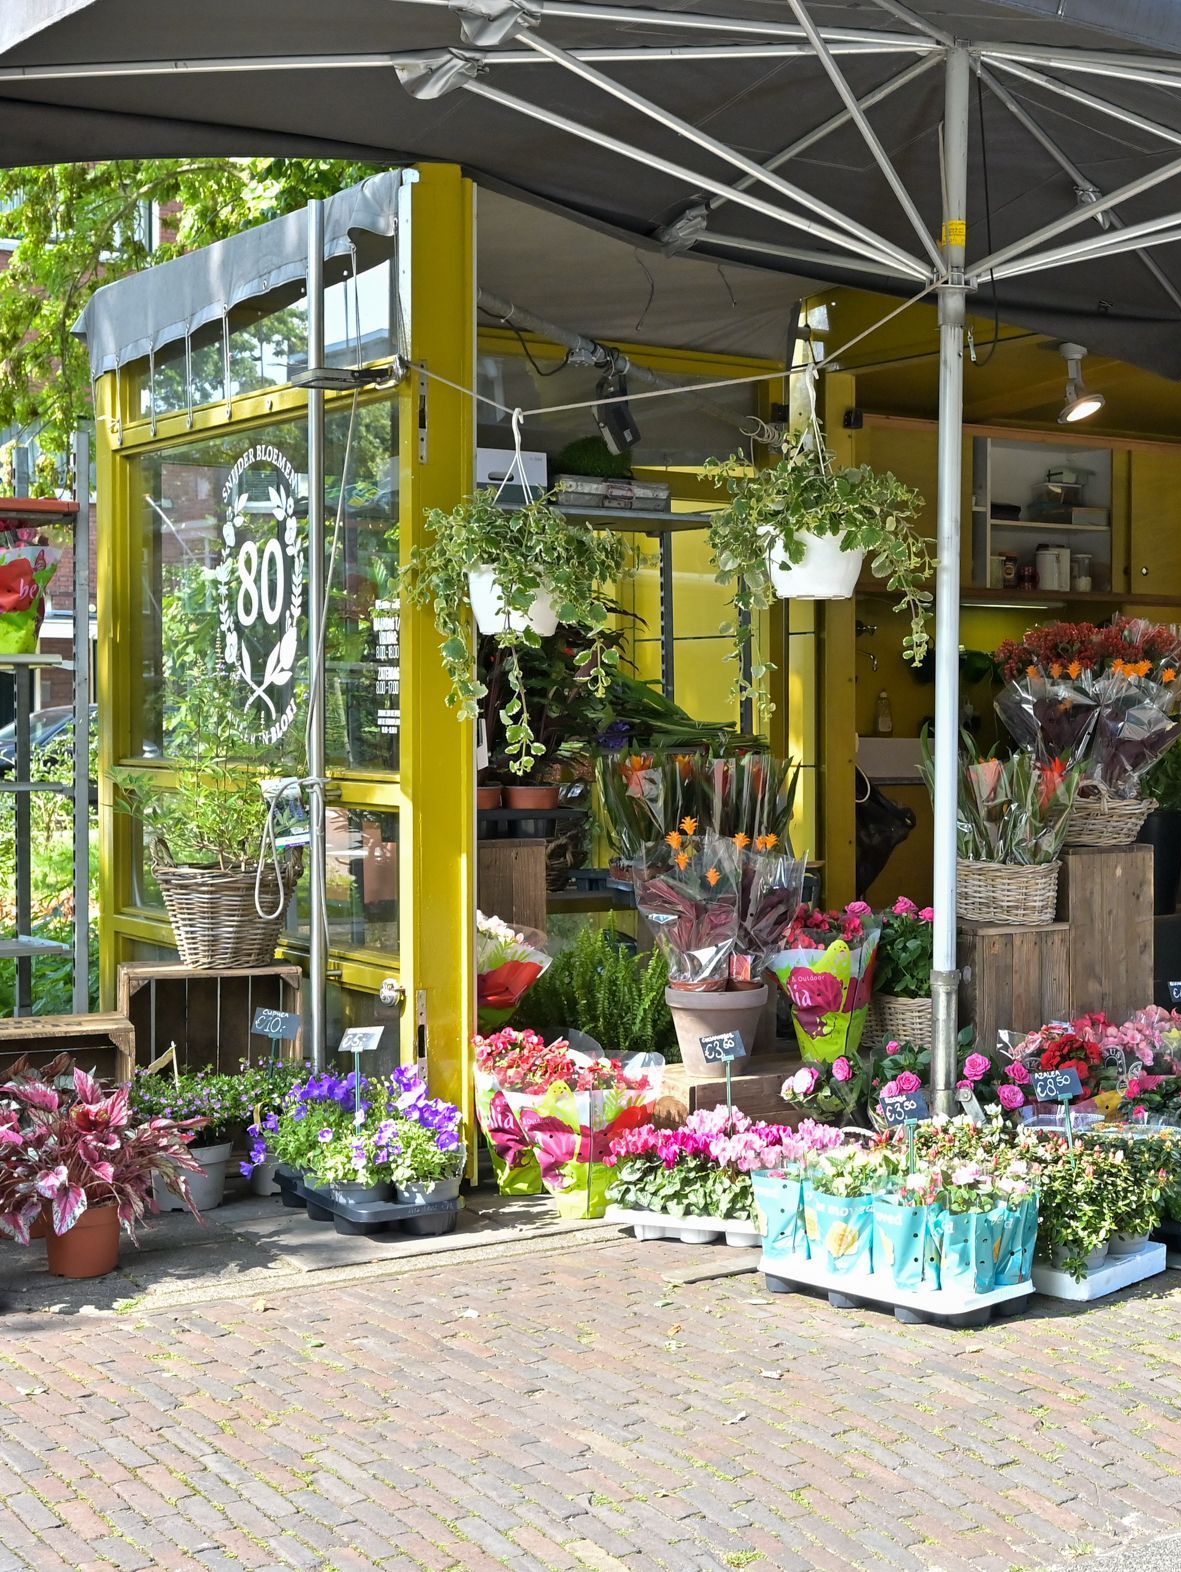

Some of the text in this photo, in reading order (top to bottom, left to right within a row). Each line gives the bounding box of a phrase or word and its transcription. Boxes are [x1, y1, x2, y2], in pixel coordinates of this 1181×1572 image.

[222, 445, 297, 503] SNIJDER BLOEMEN
[237, 538, 284, 626] 80
[1034, 1070, 1061, 1080] AZALEA
